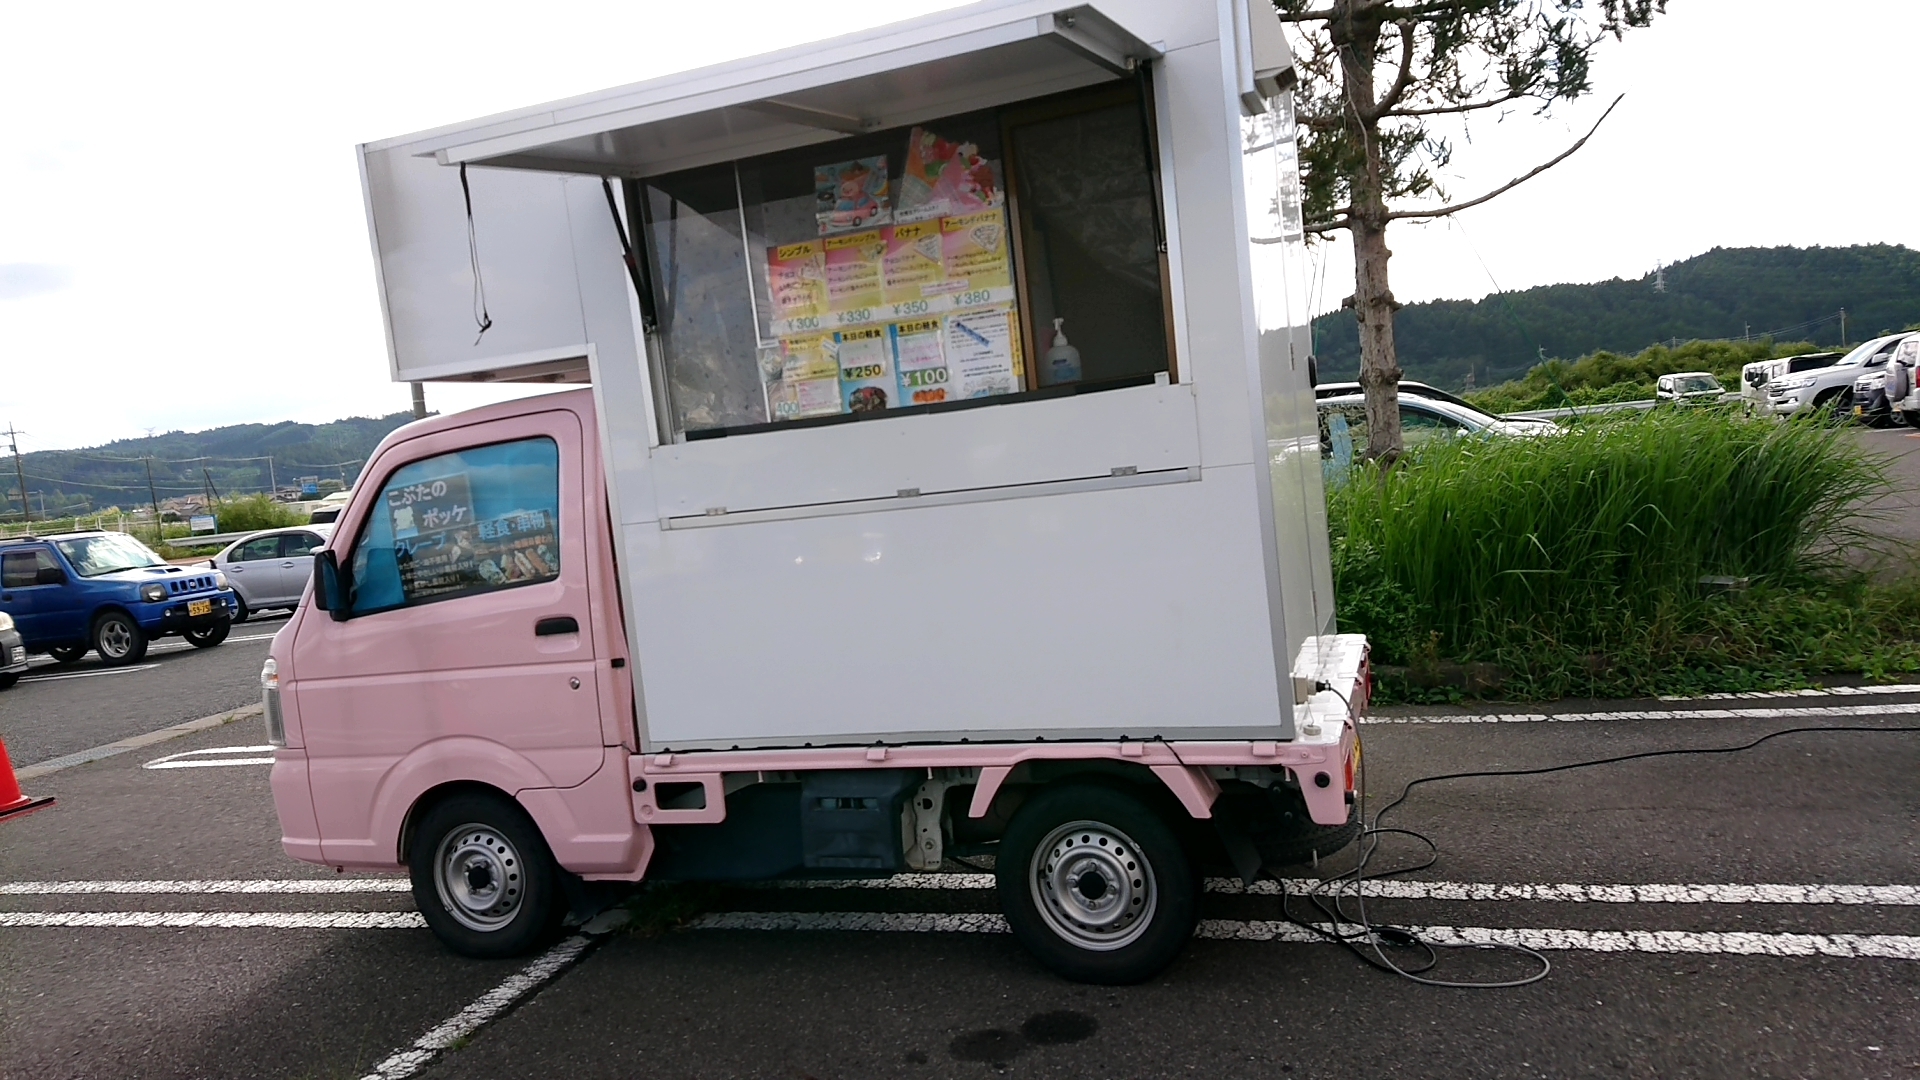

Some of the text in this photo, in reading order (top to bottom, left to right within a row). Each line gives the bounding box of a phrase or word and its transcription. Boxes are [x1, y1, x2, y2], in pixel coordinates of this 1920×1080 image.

[895, 226, 921, 238] バナナ
[779, 245, 812, 258] シンプル
[954, 290, 990, 305] ¥380
[836, 308, 871, 323] ¥330
[893, 300, 928, 316] ¥350
[787, 316, 819, 330] ¥300
[899, 320, 939, 333] 本日の軽食
[842, 329, 882, 342] 本日の軽食
[843, 364, 881, 379] ¥250
[901, 368, 947, 387] ¥100
[388, 480, 447, 506] こぶたの
[422, 504, 467, 528] ポッケ
[395, 531, 447, 558] クレープ
